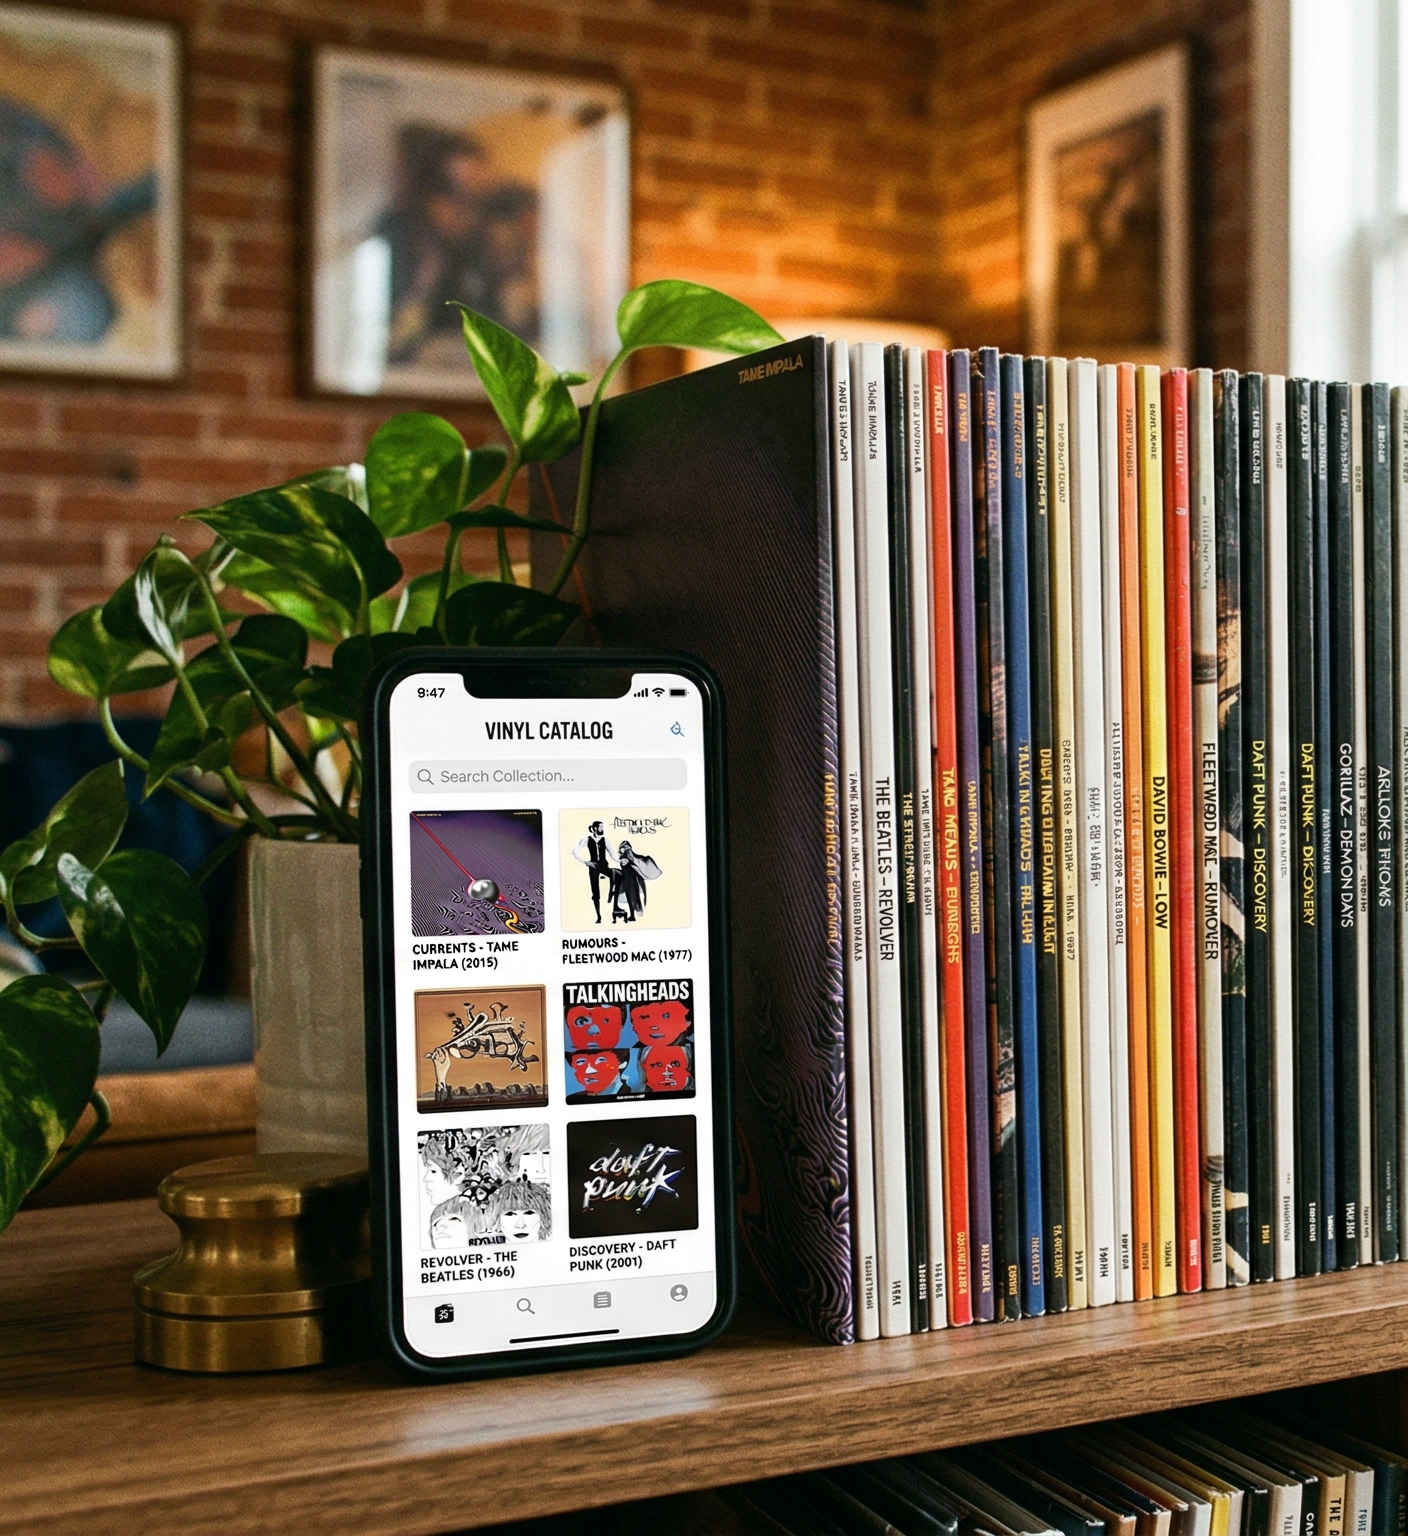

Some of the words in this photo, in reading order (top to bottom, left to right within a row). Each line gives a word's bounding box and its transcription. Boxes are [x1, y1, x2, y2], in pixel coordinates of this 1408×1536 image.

[417, 687, 446, 698] 9:47
[485, 721, 535, 740] VINYL
[539, 721, 613, 740] CATALOG
[440, 769, 489, 783] Search
[492, 769, 575, 783] Collection...
[1253, 740, 1265, 780] DAFT
[1301, 743, 1314, 782] DAFT
[876, 776, 892, 806] THE
[1340, 743, 1353, 816] GORILLAZ
[1153, 776, 1166, 825] DAVID
[1253, 784, 1266, 829] PUNK
[1302, 784, 1315, 828] PUNK
[876, 811, 893, 875] BEATLES
[1153, 829, 1167, 879] BOWIE
[1340, 830, 1353, 889] DEMON
[1254, 848, 1267, 933] DISCOVERY
[879, 889, 895, 961] REVOLVER
[1154, 893, 1168, 930] LOW
[1341, 892, 1354, 928] DAYS
[412, 942, 477, 955] CURRENTS
[486, 941, 519, 952] TAME
[562, 937, 619, 950] RUMOURS
[562, 951, 628, 964] FLEETWOOD
[631, 951, 656, 962] MAC
[658, 949, 693, 963] (1977)
[413, 958, 459, 970] IMPALA
[461, 957, 498, 971] (2015)
[420, 1253, 484, 1269] REVOLVER
[493, 1250, 518, 1262] THE
[569, 1242, 636, 1257] DISCOVERY
[646, 1239, 677, 1251] DAFT
[569, 1259, 603, 1272] PUNK
[605, 1256, 643, 1272] (2001)
[421, 1269, 475, 1284] BEATLES
[477, 1265, 515, 1281] (1966)
[1329, 1497, 1342, 1522] THE
